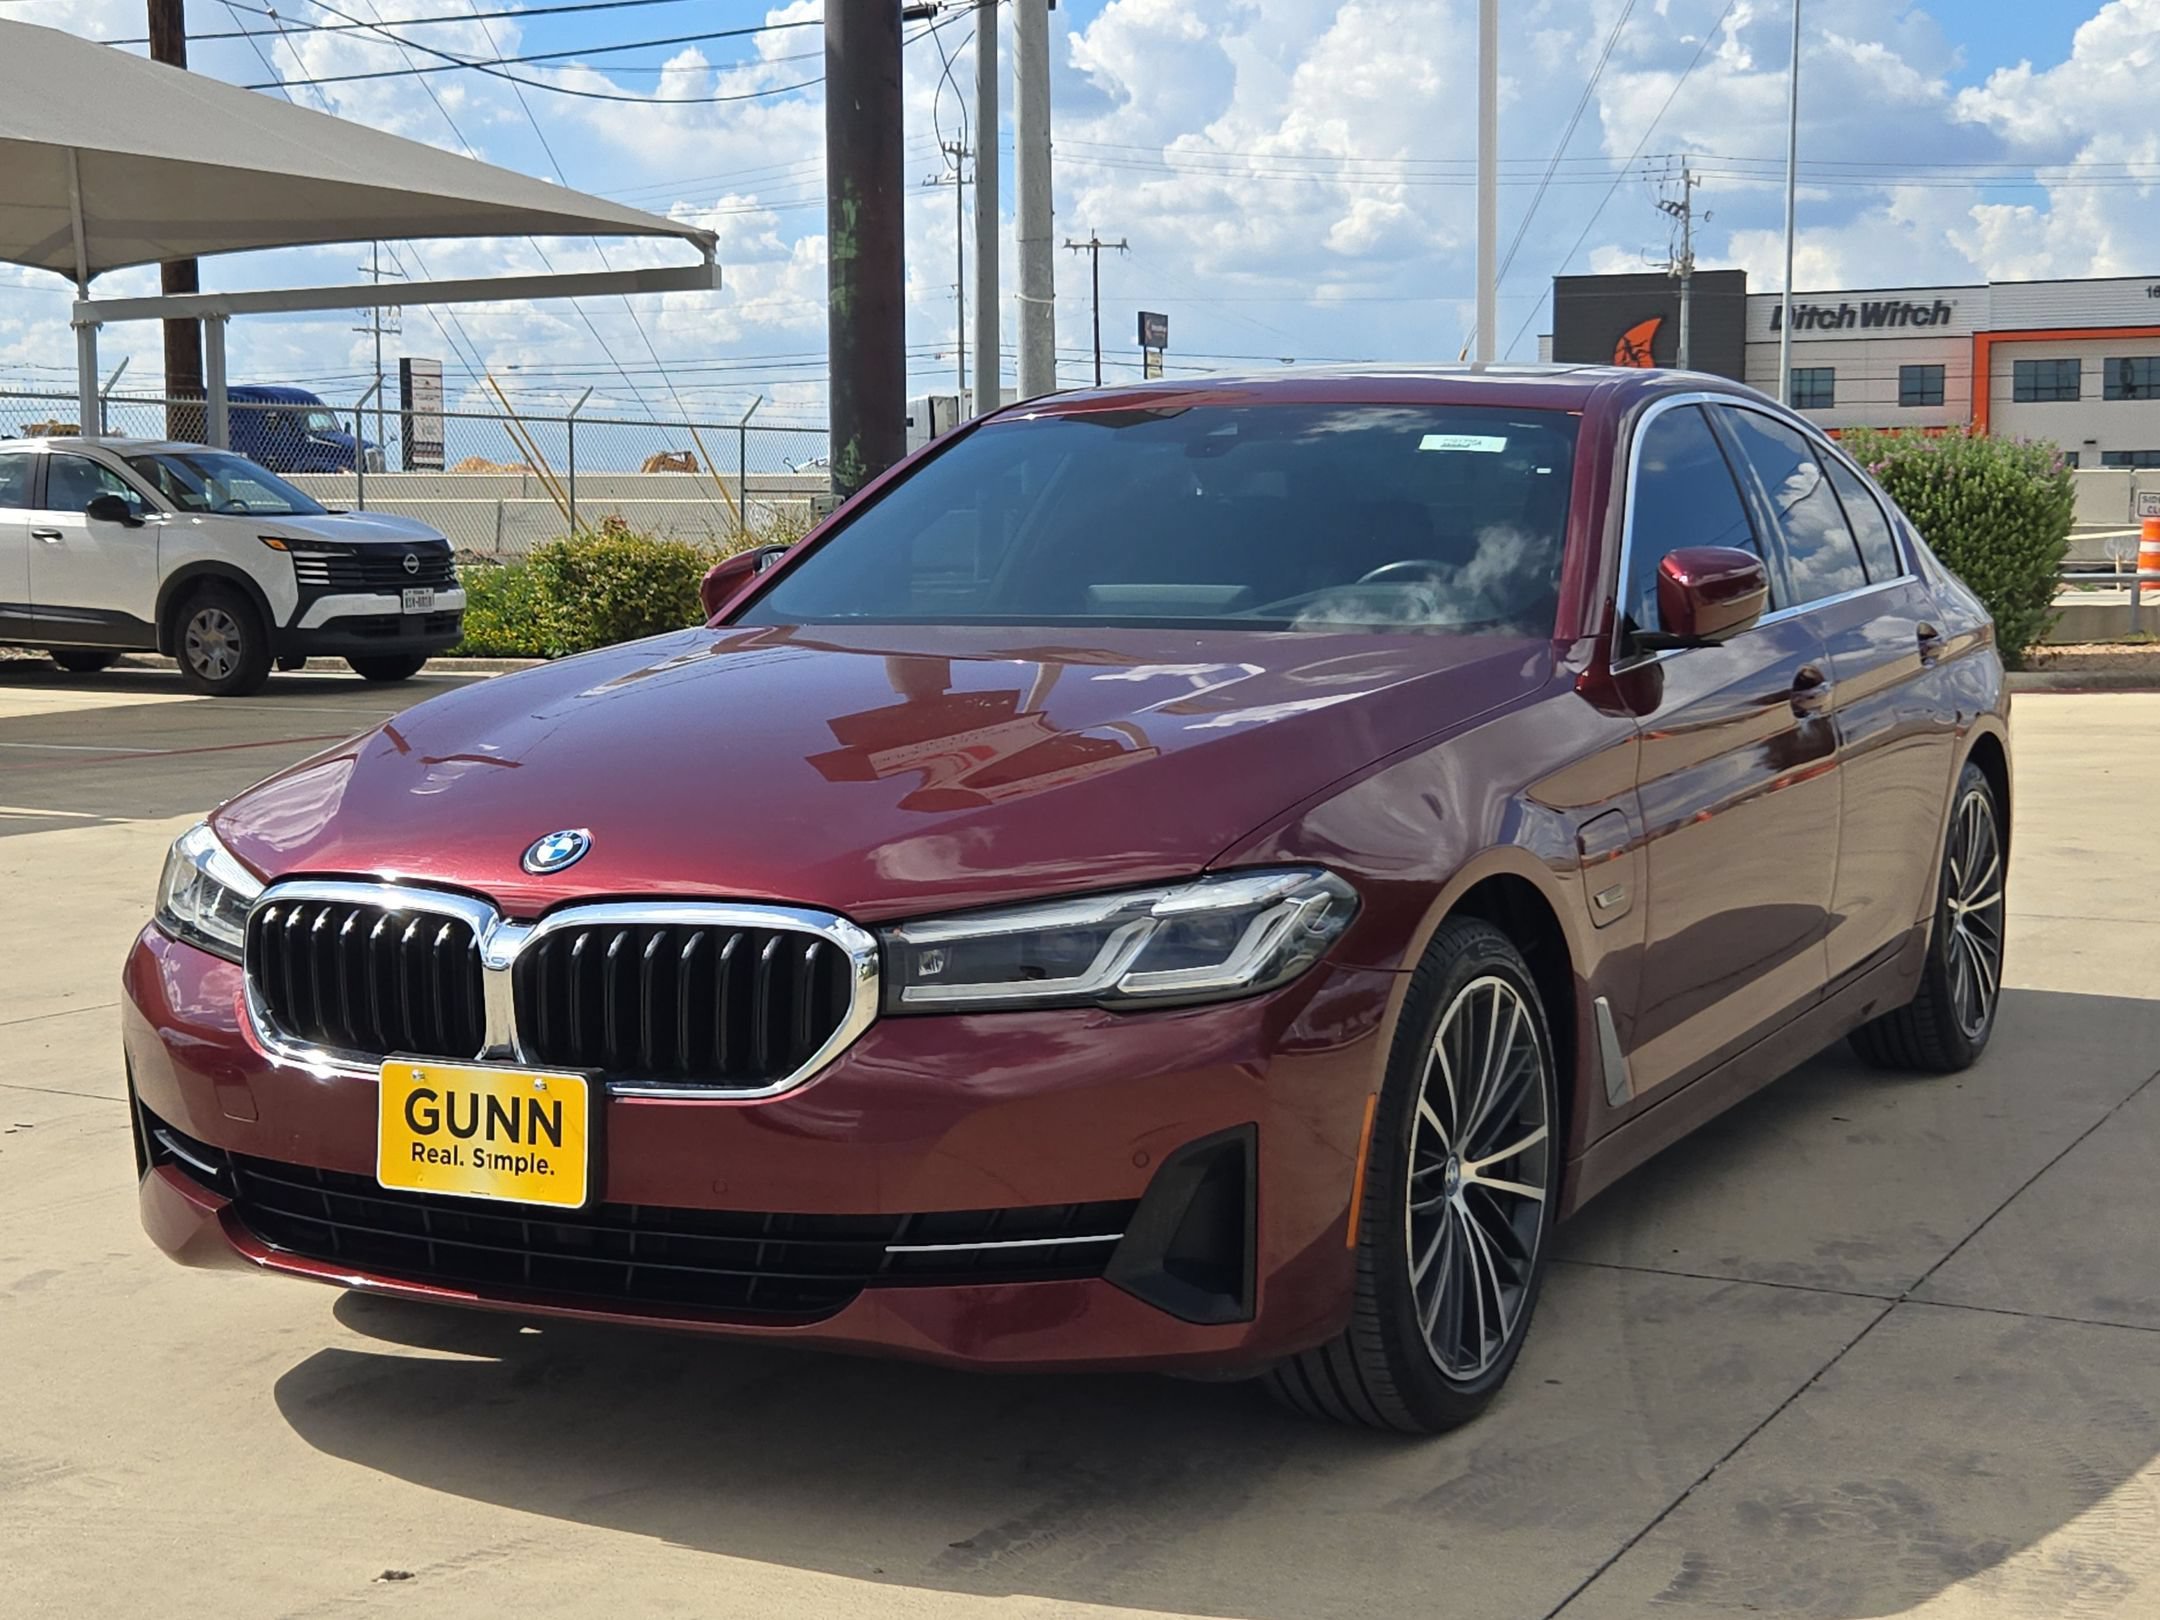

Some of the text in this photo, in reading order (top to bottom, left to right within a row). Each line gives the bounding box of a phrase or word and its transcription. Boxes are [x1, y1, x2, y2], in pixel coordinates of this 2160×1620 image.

[1769, 299, 1952, 331] Ditch Witch
[2142, 495, 2160, 504] SID
[2147, 505, 2160, 514] CL
[405, 1088, 562, 1147] GUNN
[411, 1142, 464, 1166] Real.
